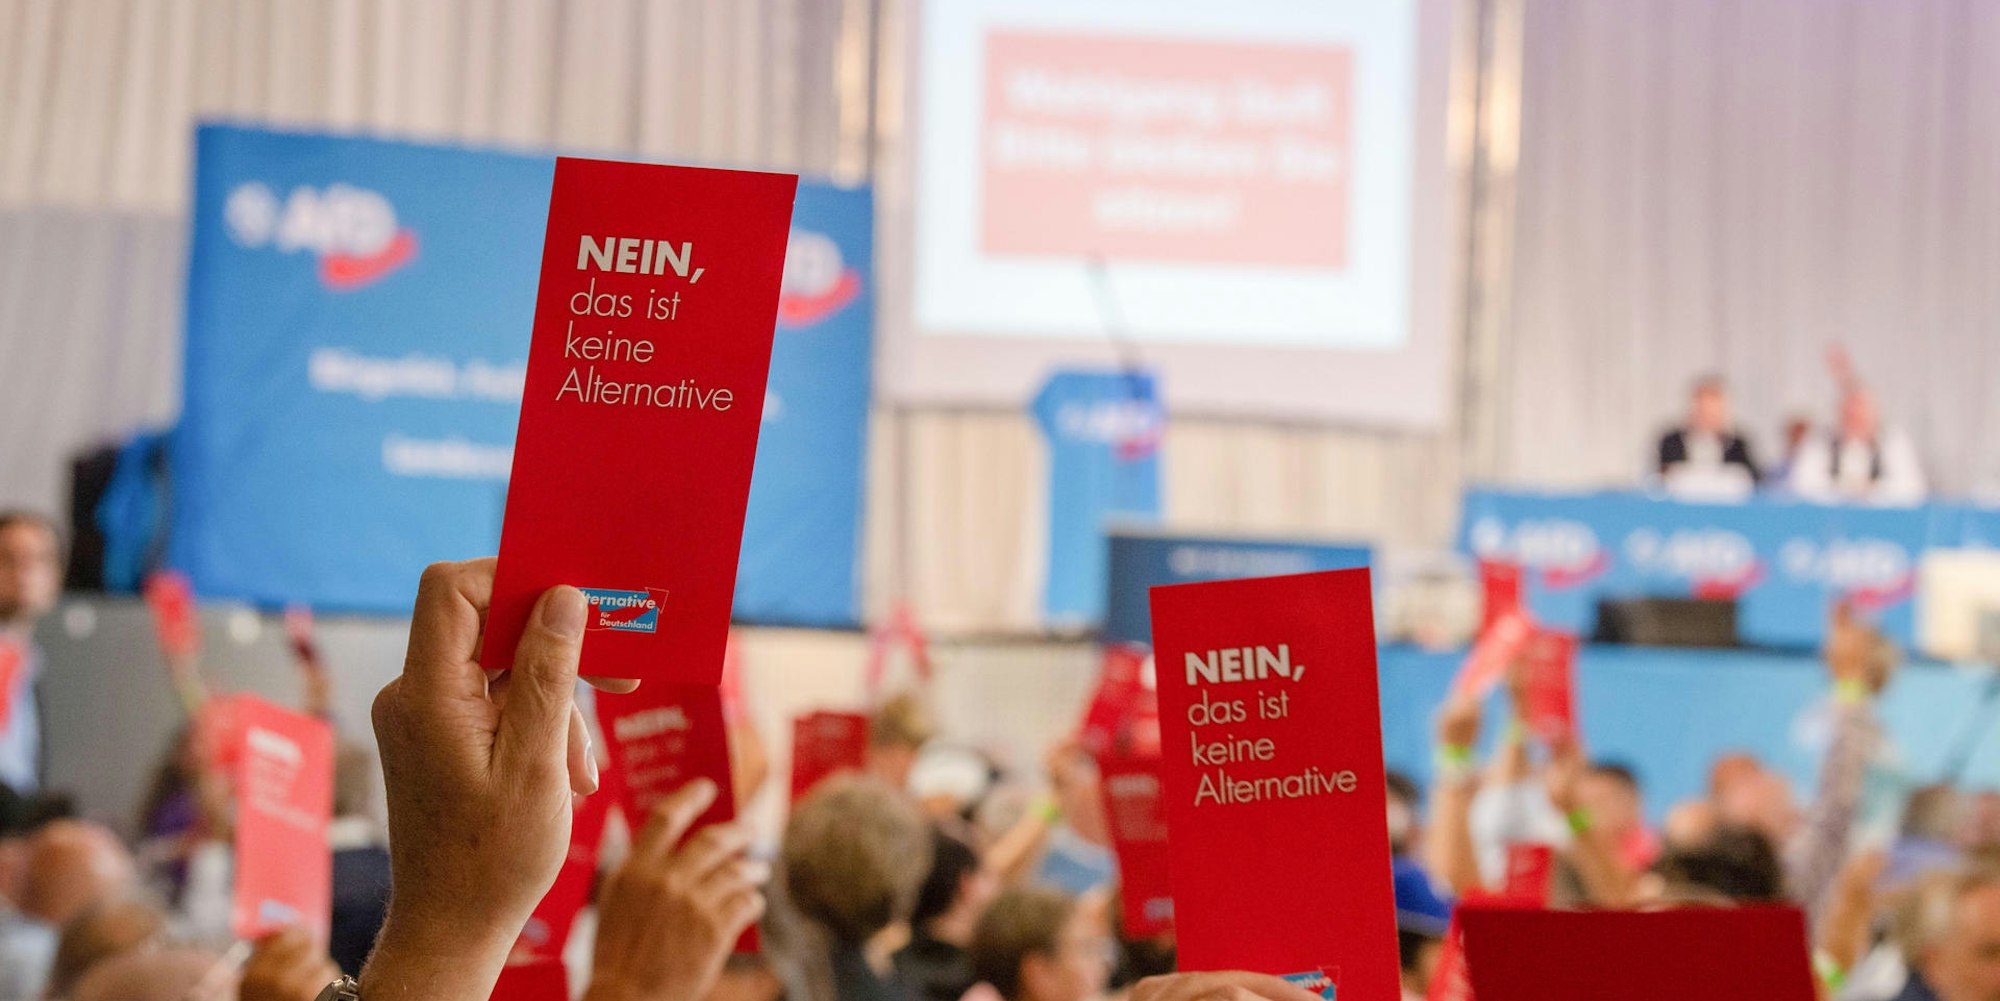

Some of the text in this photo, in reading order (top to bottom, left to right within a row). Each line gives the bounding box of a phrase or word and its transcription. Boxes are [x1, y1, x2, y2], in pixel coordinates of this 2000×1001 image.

[577, 235, 705, 284] NEIN,
[570, 277, 681, 321] das ist
[564, 320, 654, 363] keine
[555, 365, 733, 411] Alternative
[600, 618, 654, 630] Deutschland
[1184, 643, 1305, 686] NEIN,
[1187, 688, 1290, 726] das ist
[1190, 730, 1275, 767] keine
[1194, 766, 1358, 807] Alternative
